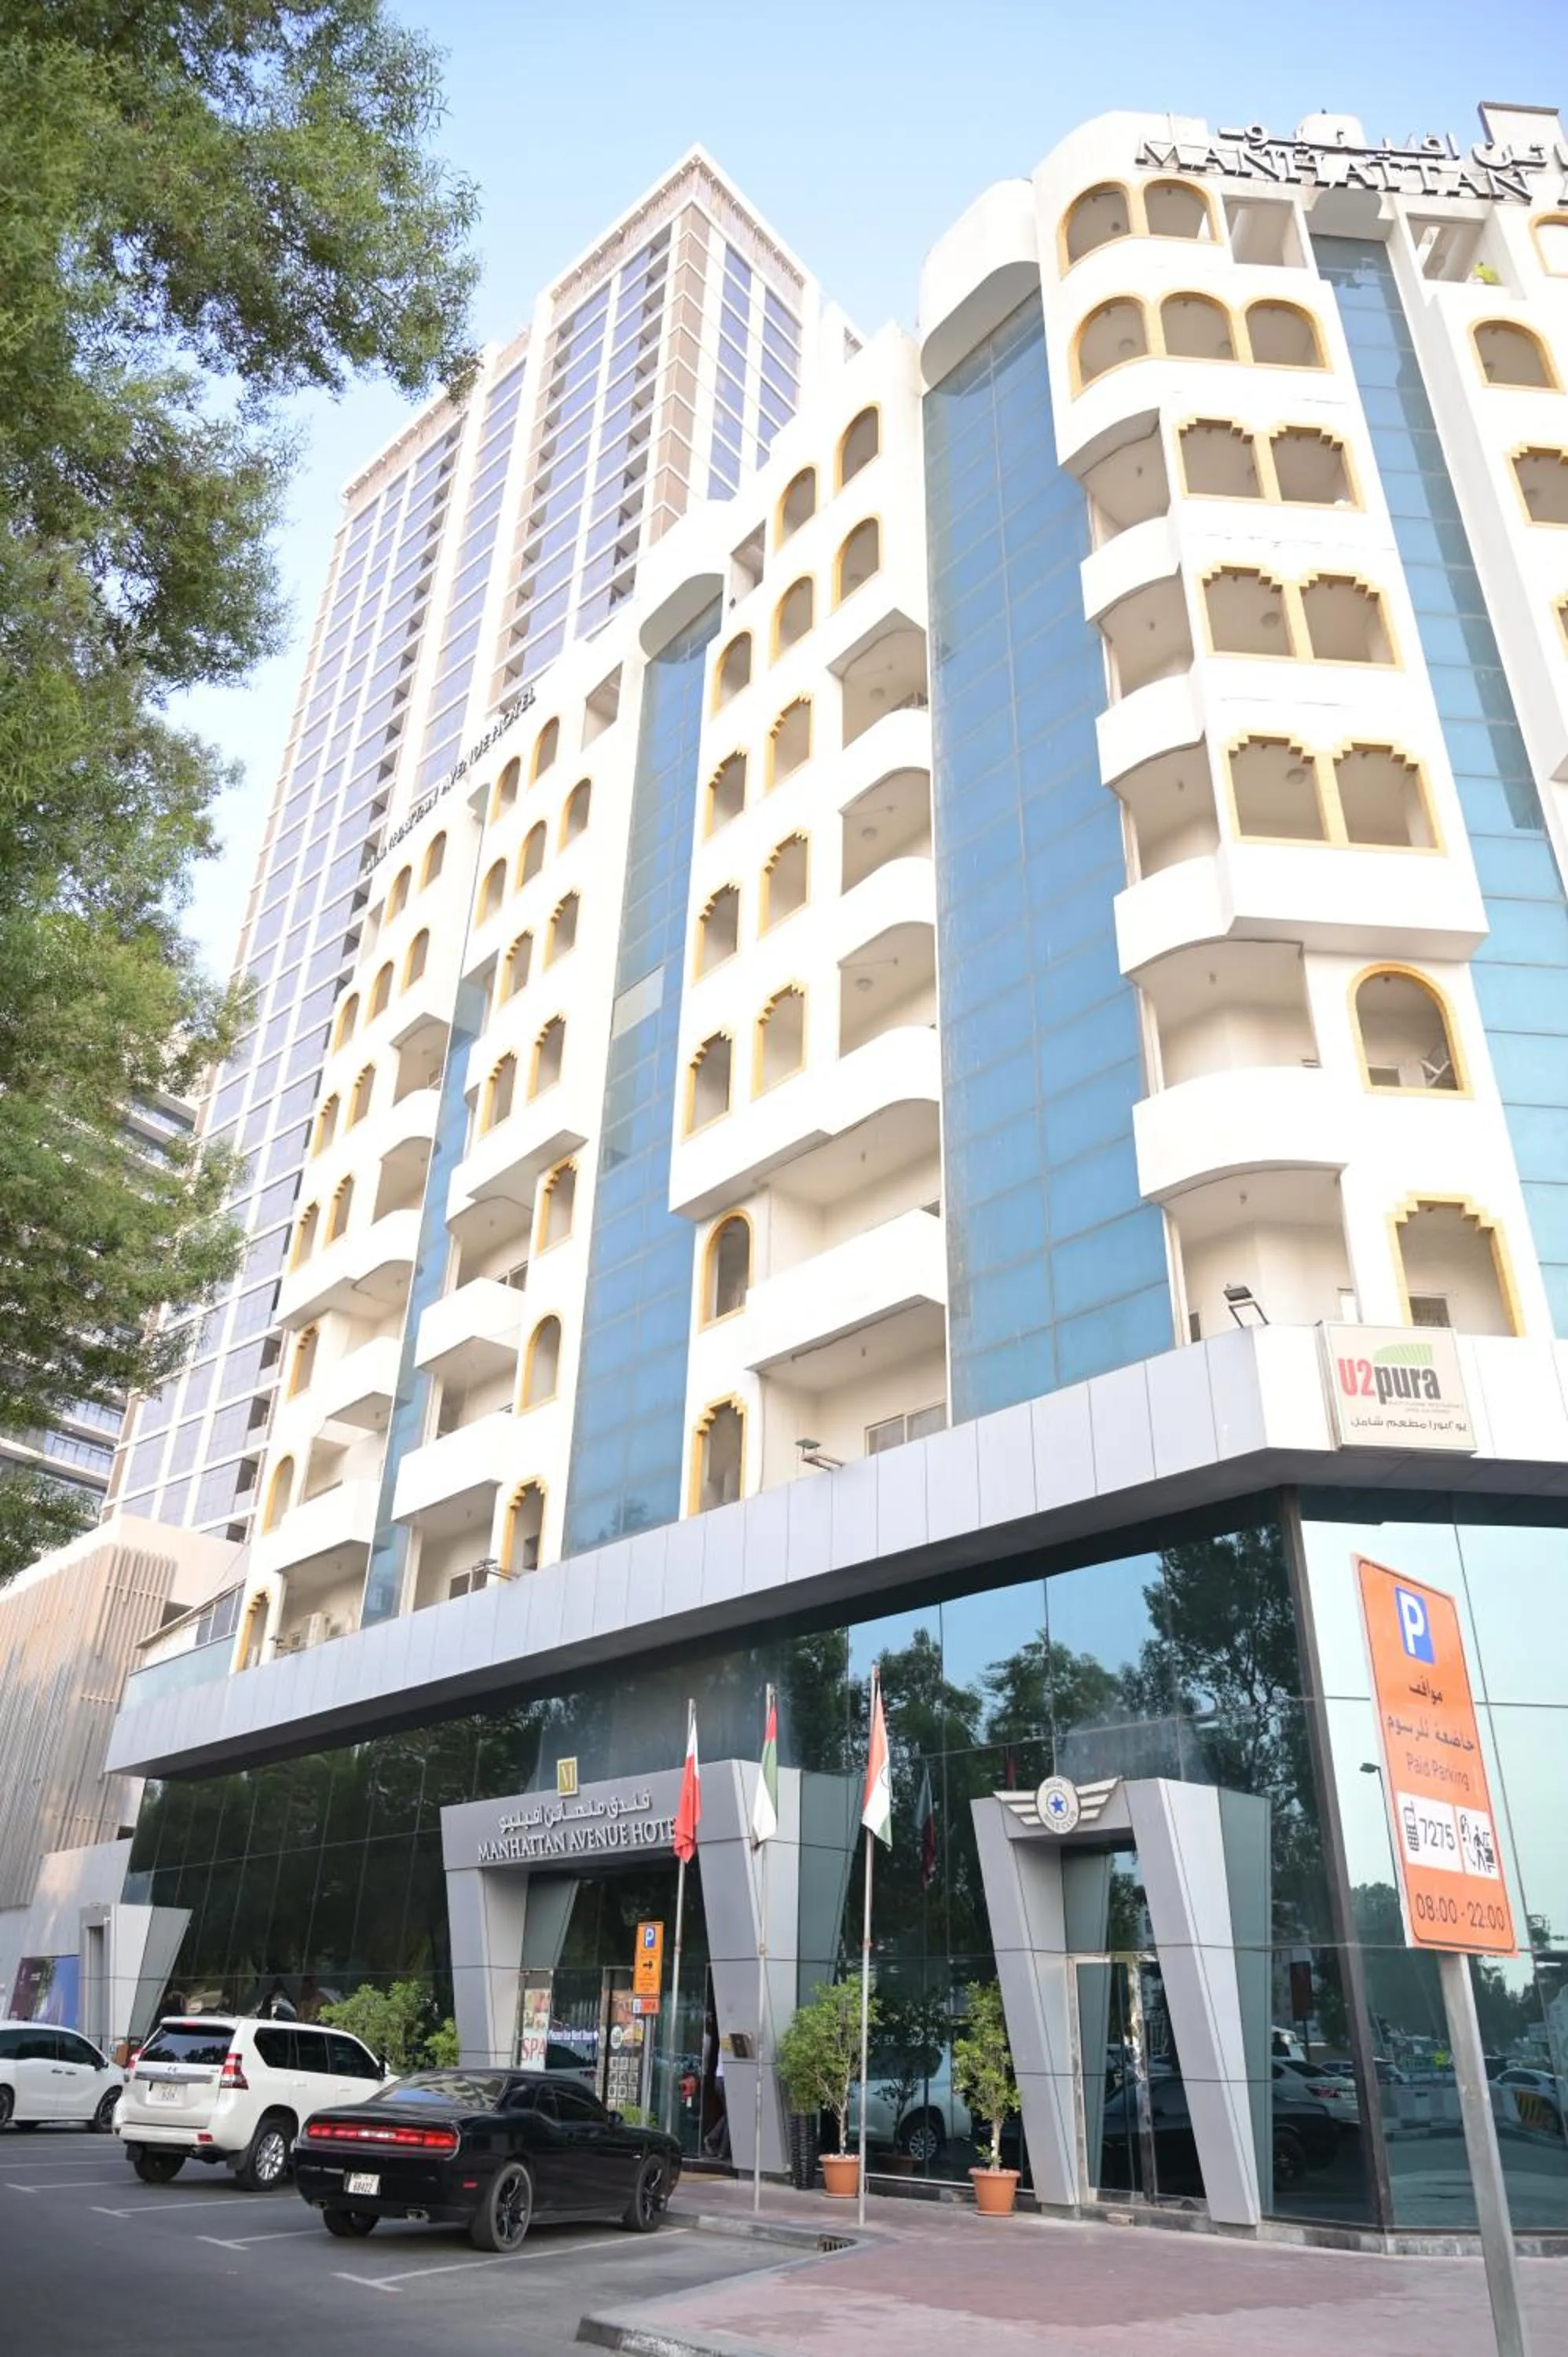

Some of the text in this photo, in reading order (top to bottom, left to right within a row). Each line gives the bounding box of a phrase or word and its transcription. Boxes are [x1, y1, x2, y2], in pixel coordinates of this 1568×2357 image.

[1135, 139, 1533, 206] MANHATTAN
[1338, 1357, 1442, 1406] U2pura
[1401, 1592, 1424, 1655] P
[1409, 1675, 1443, 1705] مواقف
[1406, 1752, 1471, 1791] Paid Parking
[478, 1817, 677, 1861] MANHATTAN AVENUE HOTE
[1419, 1817, 1456, 1850] 7275
[1416, 1893, 1457, 1924] 08:00
[1467, 1901, 1505, 1931] 22:00
[522, 2036, 548, 2061] SPA
